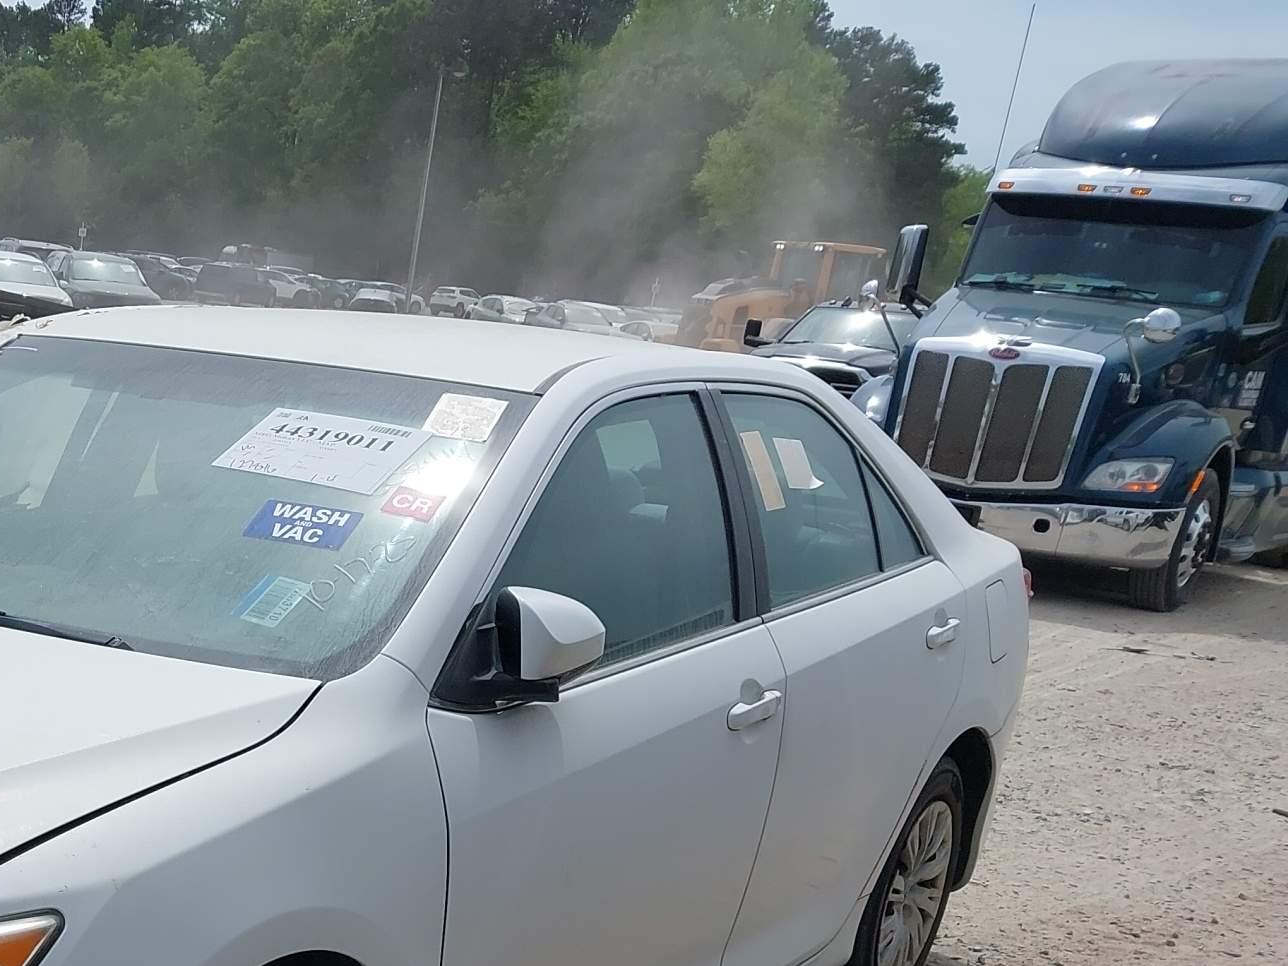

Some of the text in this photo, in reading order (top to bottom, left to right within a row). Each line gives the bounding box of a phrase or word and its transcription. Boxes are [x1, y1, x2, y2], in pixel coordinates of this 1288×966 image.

[269, 422, 395, 452] 44319011
[273, 503, 351, 527] WASH
[392, 494, 430, 514] CR
[272, 523, 323, 543] VAC
